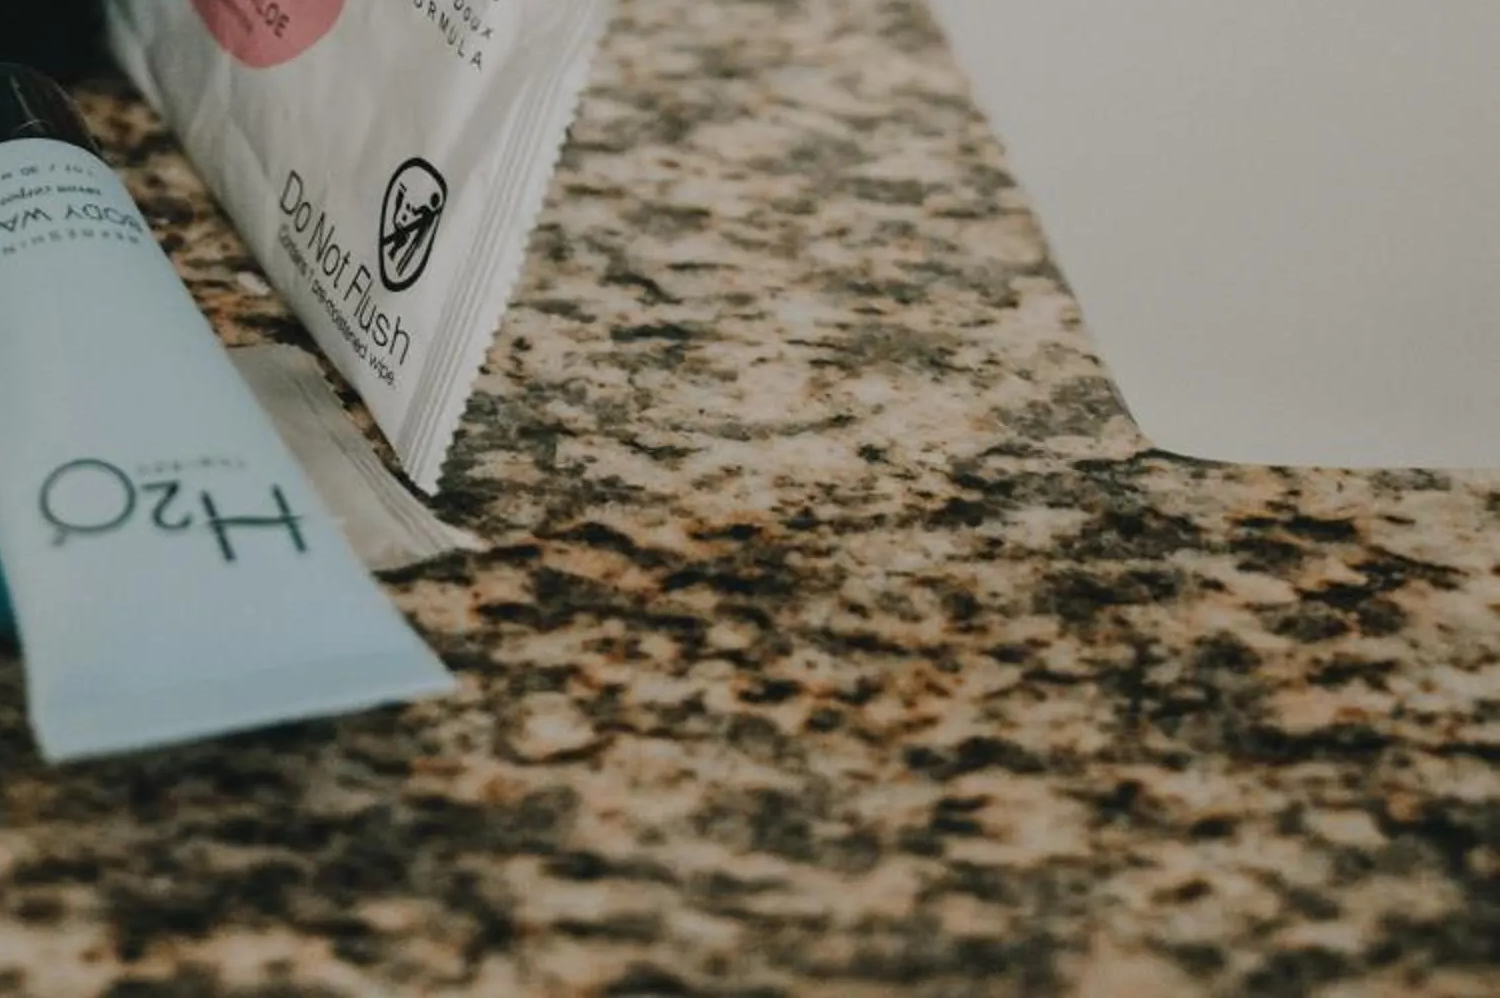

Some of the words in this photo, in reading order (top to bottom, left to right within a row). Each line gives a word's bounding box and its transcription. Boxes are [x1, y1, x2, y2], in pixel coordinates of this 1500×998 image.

[280, 169, 312, 233] Do
[308, 212, 350, 289] Not
[344, 265, 410, 366] Flush
[39, 458, 307, 563] H2O
